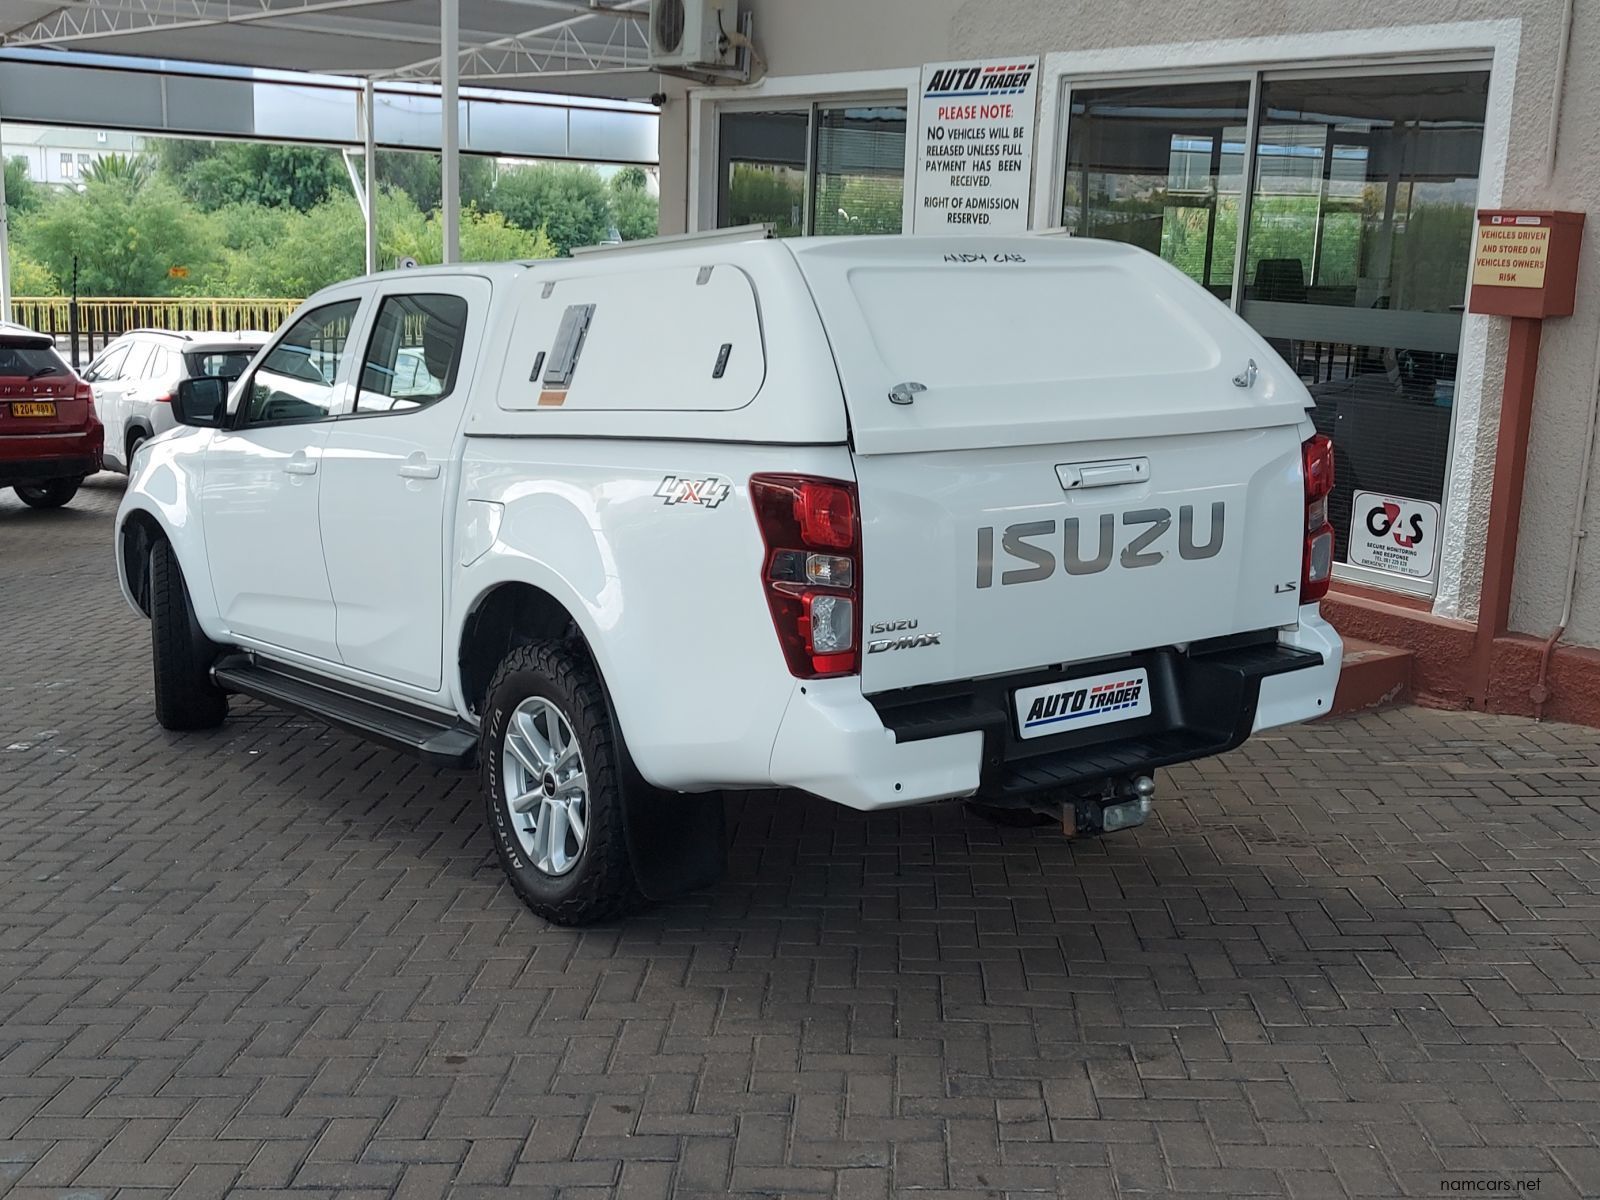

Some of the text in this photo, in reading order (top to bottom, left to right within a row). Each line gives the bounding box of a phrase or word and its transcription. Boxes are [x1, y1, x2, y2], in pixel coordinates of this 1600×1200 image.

[926, 67, 1032, 92] AUTO TRADER
[938, 104, 1013, 120] PLEASE NOTE:
[927, 126, 1024, 140] NO VEHICLES WILL BE
[926, 144, 1023, 156] RELEASED UNLESS FULL
[925, 159, 1022, 172] PAYMENT HAS BEEN
[950, 175, 991, 187] RECEIVED.
[924, 196, 1019, 210] RIGHT OF ADMISSION
[947, 212, 991, 225] RESERVED.
[1481, 230, 1547, 240] VEHICLES DRIVEN
[1482, 244, 1541, 254] AND STORED ON
[1476, 258, 1544, 268] VEHICLES OWNERS
[1498, 273, 1516, 281] RISK
[1366, 502, 1424, 548] G4S
[976, 501, 1225, 589] ISUZU
[1367, 542, 1418, 557] SECURE MONITORING
[1384, 551, 1409, 561] RESPONSE
[1274, 581, 1296, 593] LS
[870, 619, 918, 634] ISUZU
[1026, 686, 1142, 722] AUTO TRADER
[490, 708, 503, 739] T/A
